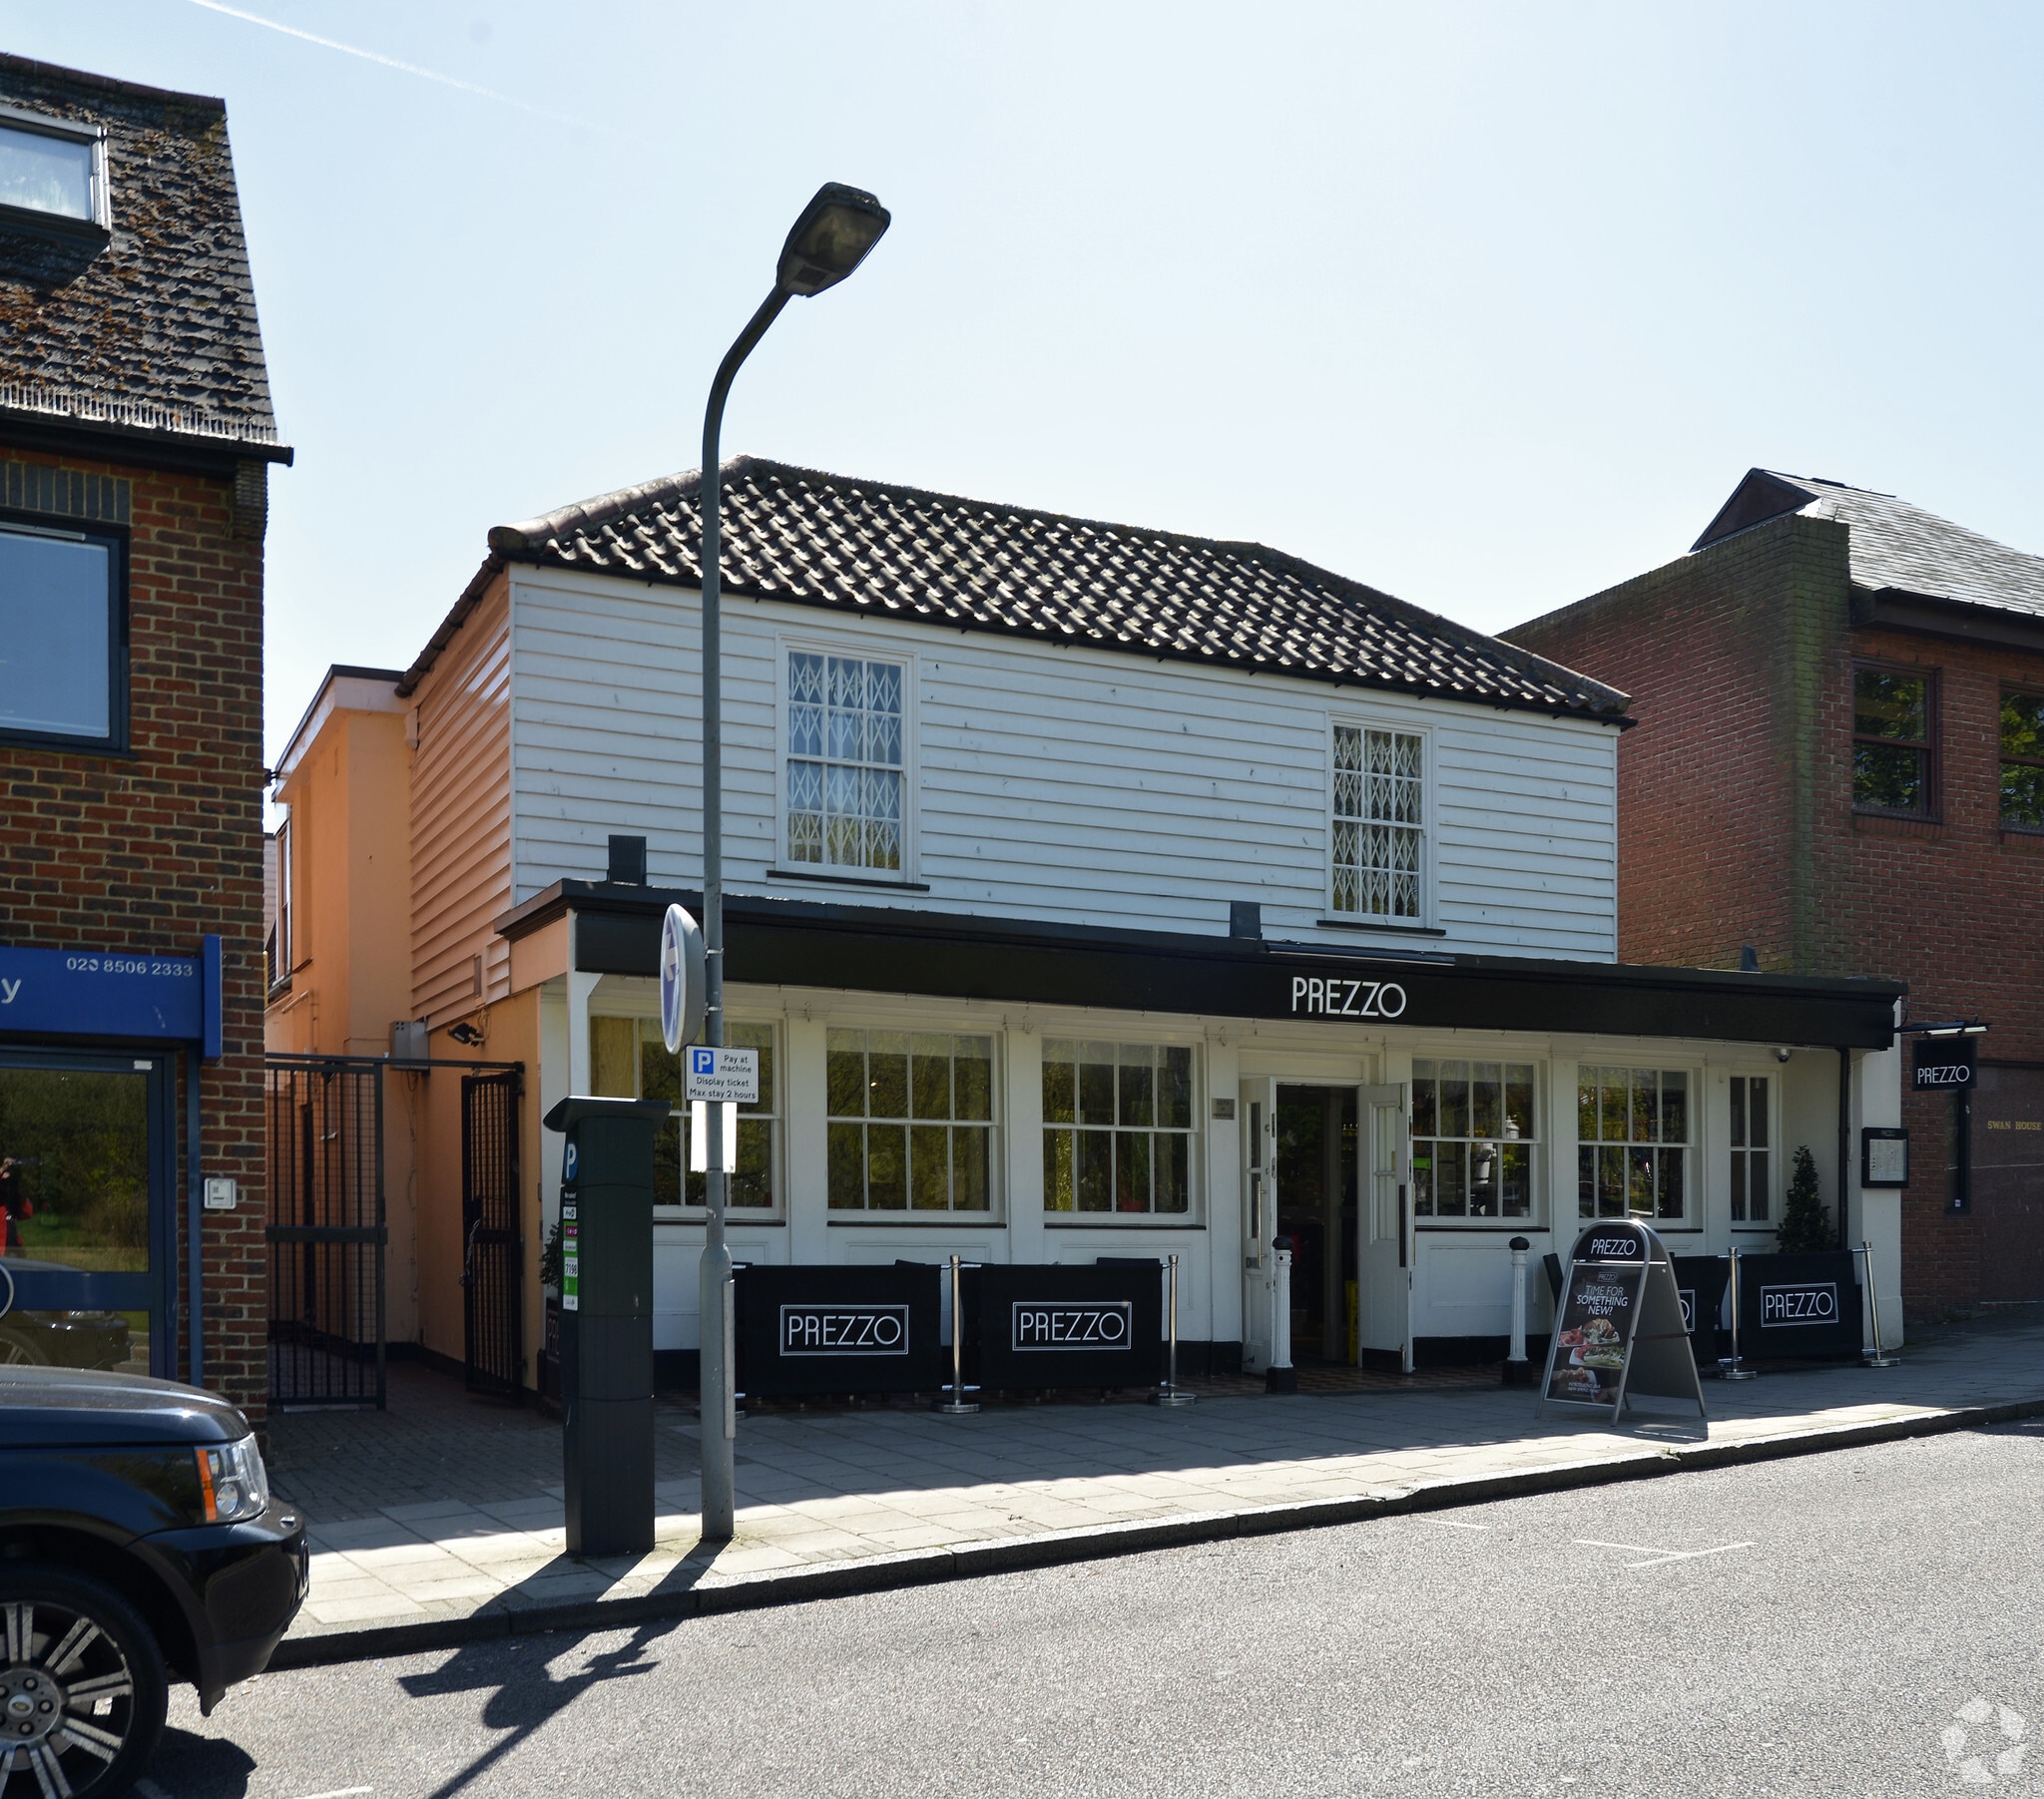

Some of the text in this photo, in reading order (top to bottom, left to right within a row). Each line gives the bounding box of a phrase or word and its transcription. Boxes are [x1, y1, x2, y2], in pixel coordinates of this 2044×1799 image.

[66, 957, 193, 977] 020 8506 2333
[1291, 976, 1407, 1018] PREZZO
[697, 1052, 712, 1073] P
[724, 1054, 738, 1065] Pay
[720, 1065, 752, 1074] machine
[1917, 1065, 1970, 1085] PREZZO
[696, 1077, 750, 1088] Display ticket
[689, 1088, 706, 1097] Max
[708, 1090, 725, 1099] stay
[1987, 1120, 2042, 1130] SWAN HOUSE
[566, 1142, 577, 1179] P
[1590, 1238, 1637, 1255] PREZZO
[1586, 1285, 1624, 1296] TIME FOR
[1577, 1294, 1628, 1306] SOMETHING
[1766, 1291, 1833, 1319] PREZZO
[1588, 1305, 1613, 1316] NEW?
[788, 1315, 901, 1346] PREZZO
[1020, 1311, 1125, 1341] PREZZO
